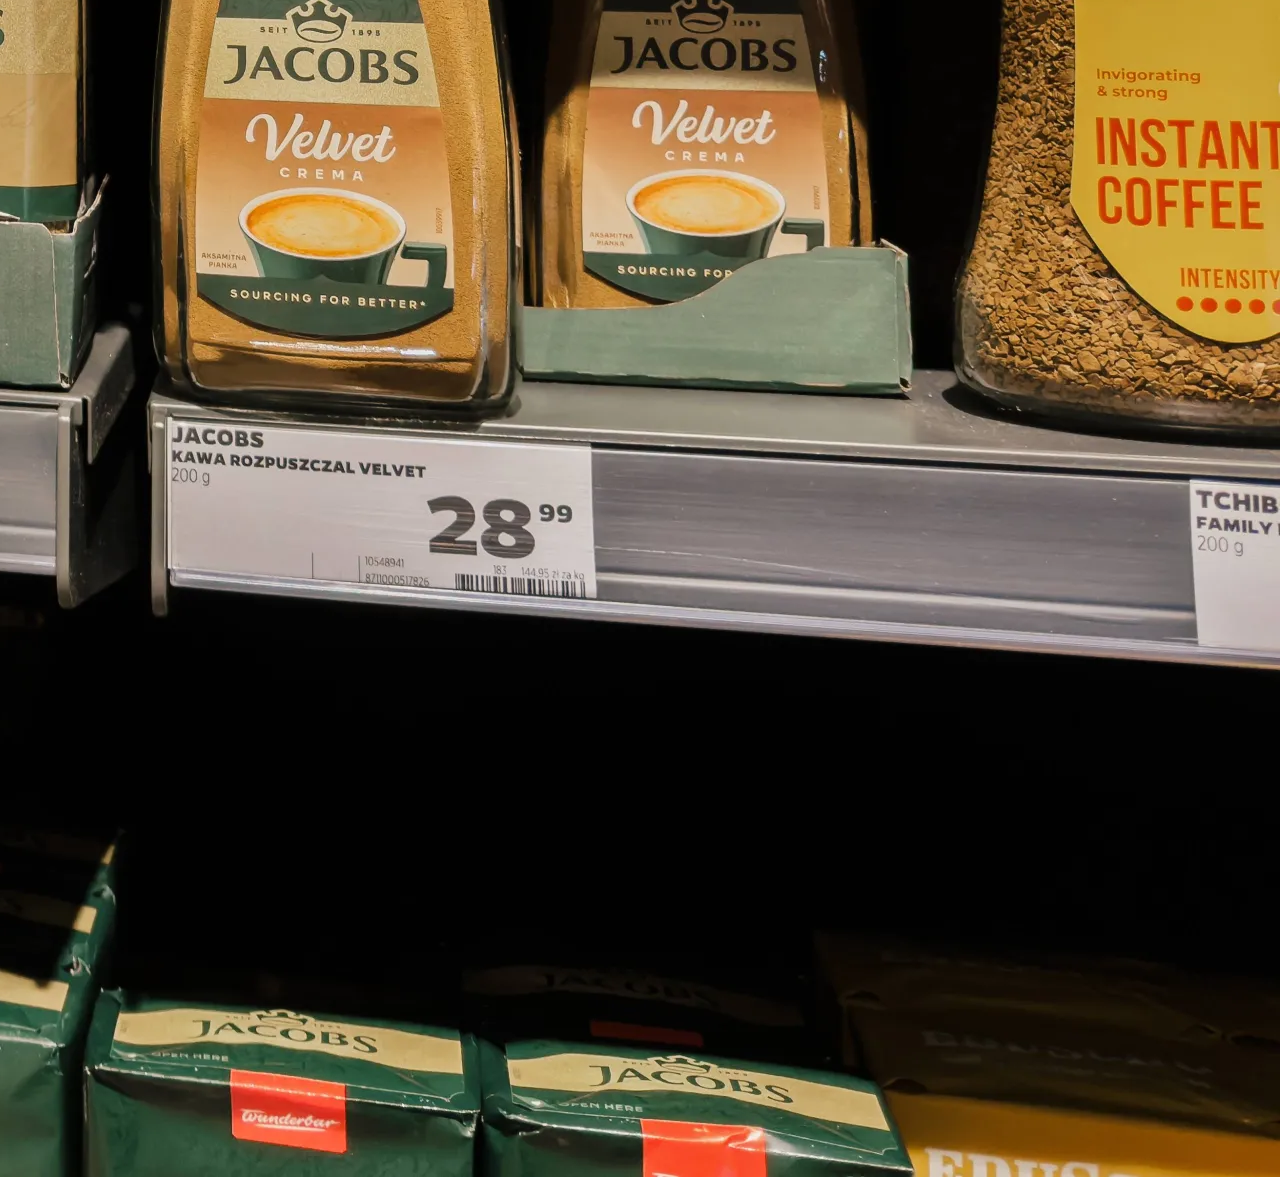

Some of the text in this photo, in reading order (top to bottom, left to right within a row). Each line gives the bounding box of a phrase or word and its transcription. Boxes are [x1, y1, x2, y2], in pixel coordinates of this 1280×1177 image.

[224, 44, 420, 87] JACOBS
[611, 35, 798, 74] JACOBS
[1095, 67, 1201, 86] Invigorating
[1111, 85, 1169, 101] strong
[631, 99, 776, 146] Velvet
[245, 113, 396, 163] Velvet
[1095, 116, 1280, 171] INSTANT
[665, 150, 746, 164] CREMA
[279, 166, 365, 183] CREMA
[1097, 176, 1264, 231] COFFEE
[201, 252, 247, 262] AKSAMITNA
[208, 261, 238, 270] PIANKA
[617, 264, 697, 278] SOURCING
[1179, 267, 1279, 290] INTENSITY
[230, 288, 350, 306] SOURCING FOR
[172, 426, 264, 448] JACOBS
[171, 449, 426, 478] KAWA ROZPUSZCZAL VELVET
[171, 467, 198, 484] 200
[426, 494, 573, 560] 28 99
[1196, 516, 1272, 535] FAMILY
[1197, 535, 1228, 553] 200
[192, 1019, 379, 1056] JACOBS
[240, 1108, 338, 1130] Wunderbar
